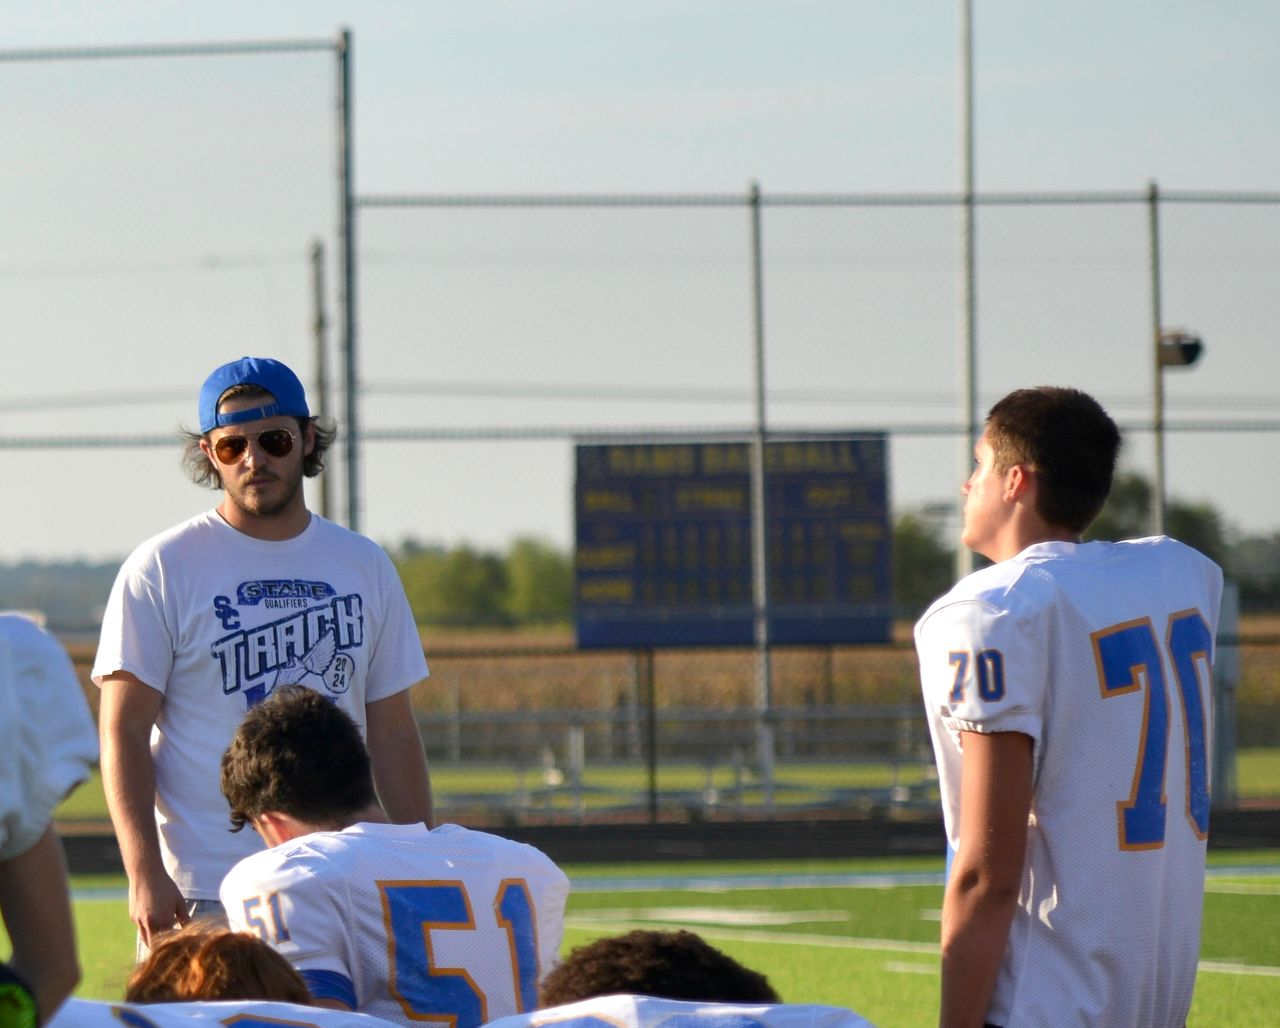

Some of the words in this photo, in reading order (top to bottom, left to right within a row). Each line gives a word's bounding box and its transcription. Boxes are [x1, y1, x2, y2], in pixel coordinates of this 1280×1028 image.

[245, 581, 329, 599] STATE
[264, 598, 308, 610] QUALIFIERS
[211, 593, 363, 695] TRACK
[333, 673, 345, 689] 24
[948, 650, 1005, 703] 70
[1090, 607, 1214, 852] 70
[243, 891, 290, 946] 51
